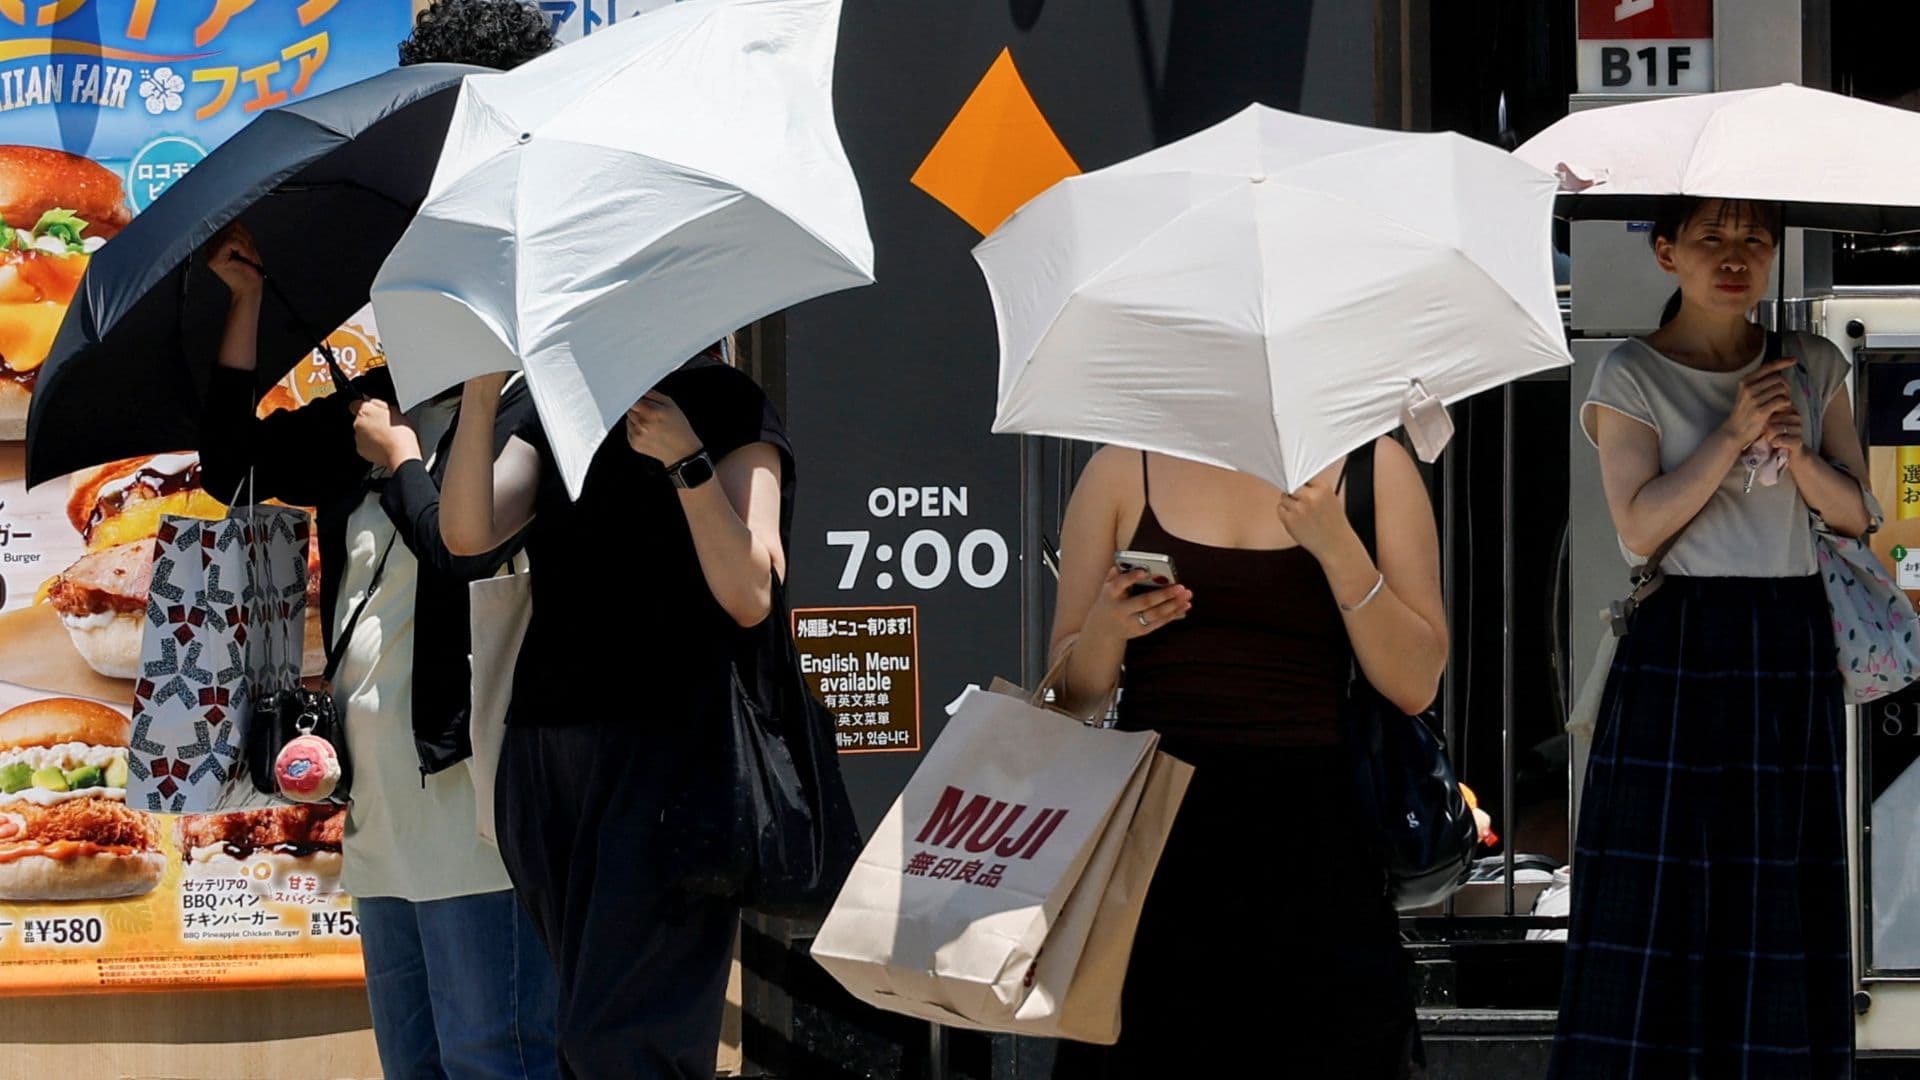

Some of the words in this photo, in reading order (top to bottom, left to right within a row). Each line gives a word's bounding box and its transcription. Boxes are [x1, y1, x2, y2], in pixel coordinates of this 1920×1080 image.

[192, 31, 330, 121] フェア
[1601, 47, 1691, 87] B1F
[0, 63, 64, 112] IIAN
[70, 63, 134, 110] FAIR
[138, 162, 196, 180] ロコモ
[868, 486, 968, 517] OPEN
[4, 553, 41, 563] Burger
[826, 529, 1009, 590] 7:00
[798, 617, 911, 638] 外国語メニュー有ります!
[800, 652, 859, 674] English
[866, 652, 910, 671] Menu
[820, 672, 891, 692] available
[824, 693, 889, 708] 有英文菜单
[835, 712, 890, 727] 英文菜單
[866, 730, 909, 746] 있습니다
[914, 785, 1069, 860] MUJI
[903, 851, 1007, 888] 無印良品
[182, 879, 248, 892] ゼッテリアの
[288, 876, 317, 892] 甘辛
[183, 911, 279, 928] チキンバーガー
[36, 918, 102, 943] ¥580
[202, 931, 240, 940] Pineapple
[242, 930, 272, 938] Chicken
